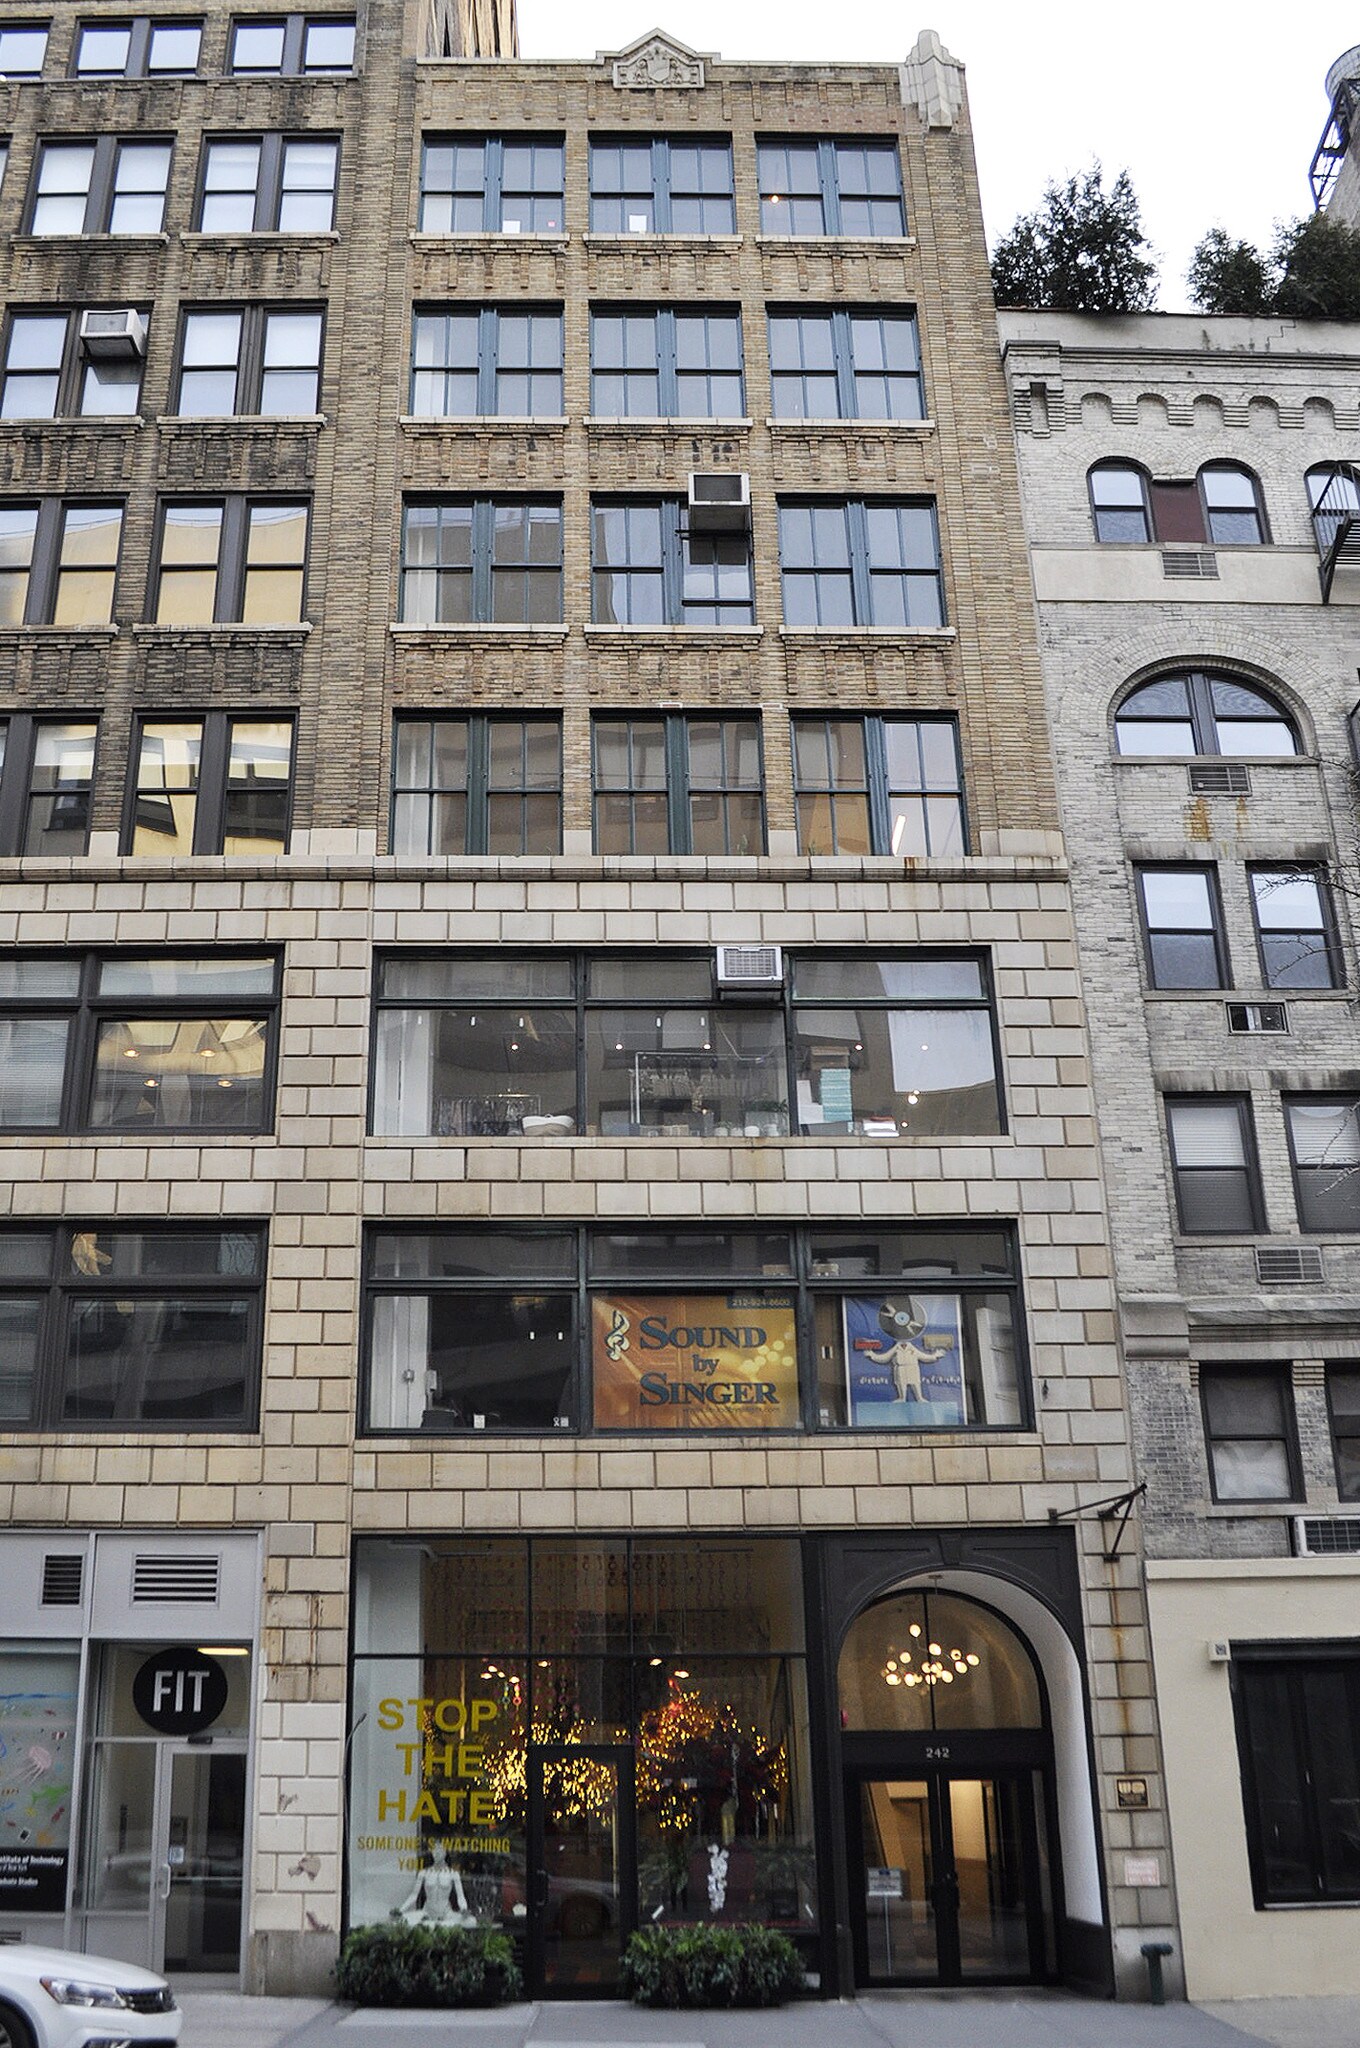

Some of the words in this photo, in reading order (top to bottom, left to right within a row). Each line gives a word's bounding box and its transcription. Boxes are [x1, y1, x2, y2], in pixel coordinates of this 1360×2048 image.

[640, 1316, 767, 1350] SOUND
[692, 1354, 719, 1376] by
[639, 1372, 779, 1406] SINGER
[152, 1670, 210, 1712] FIT
[377, 1697, 498, 1733] STOP
[395, 1742, 485, 1778] THE
[926, 1747, 950, 1758] 242
[377, 1788, 496, 1825] HATE
[357, 1835, 436, 1851] SOMEONE'S
[441, 1836, 511, 1854] WATCHING
